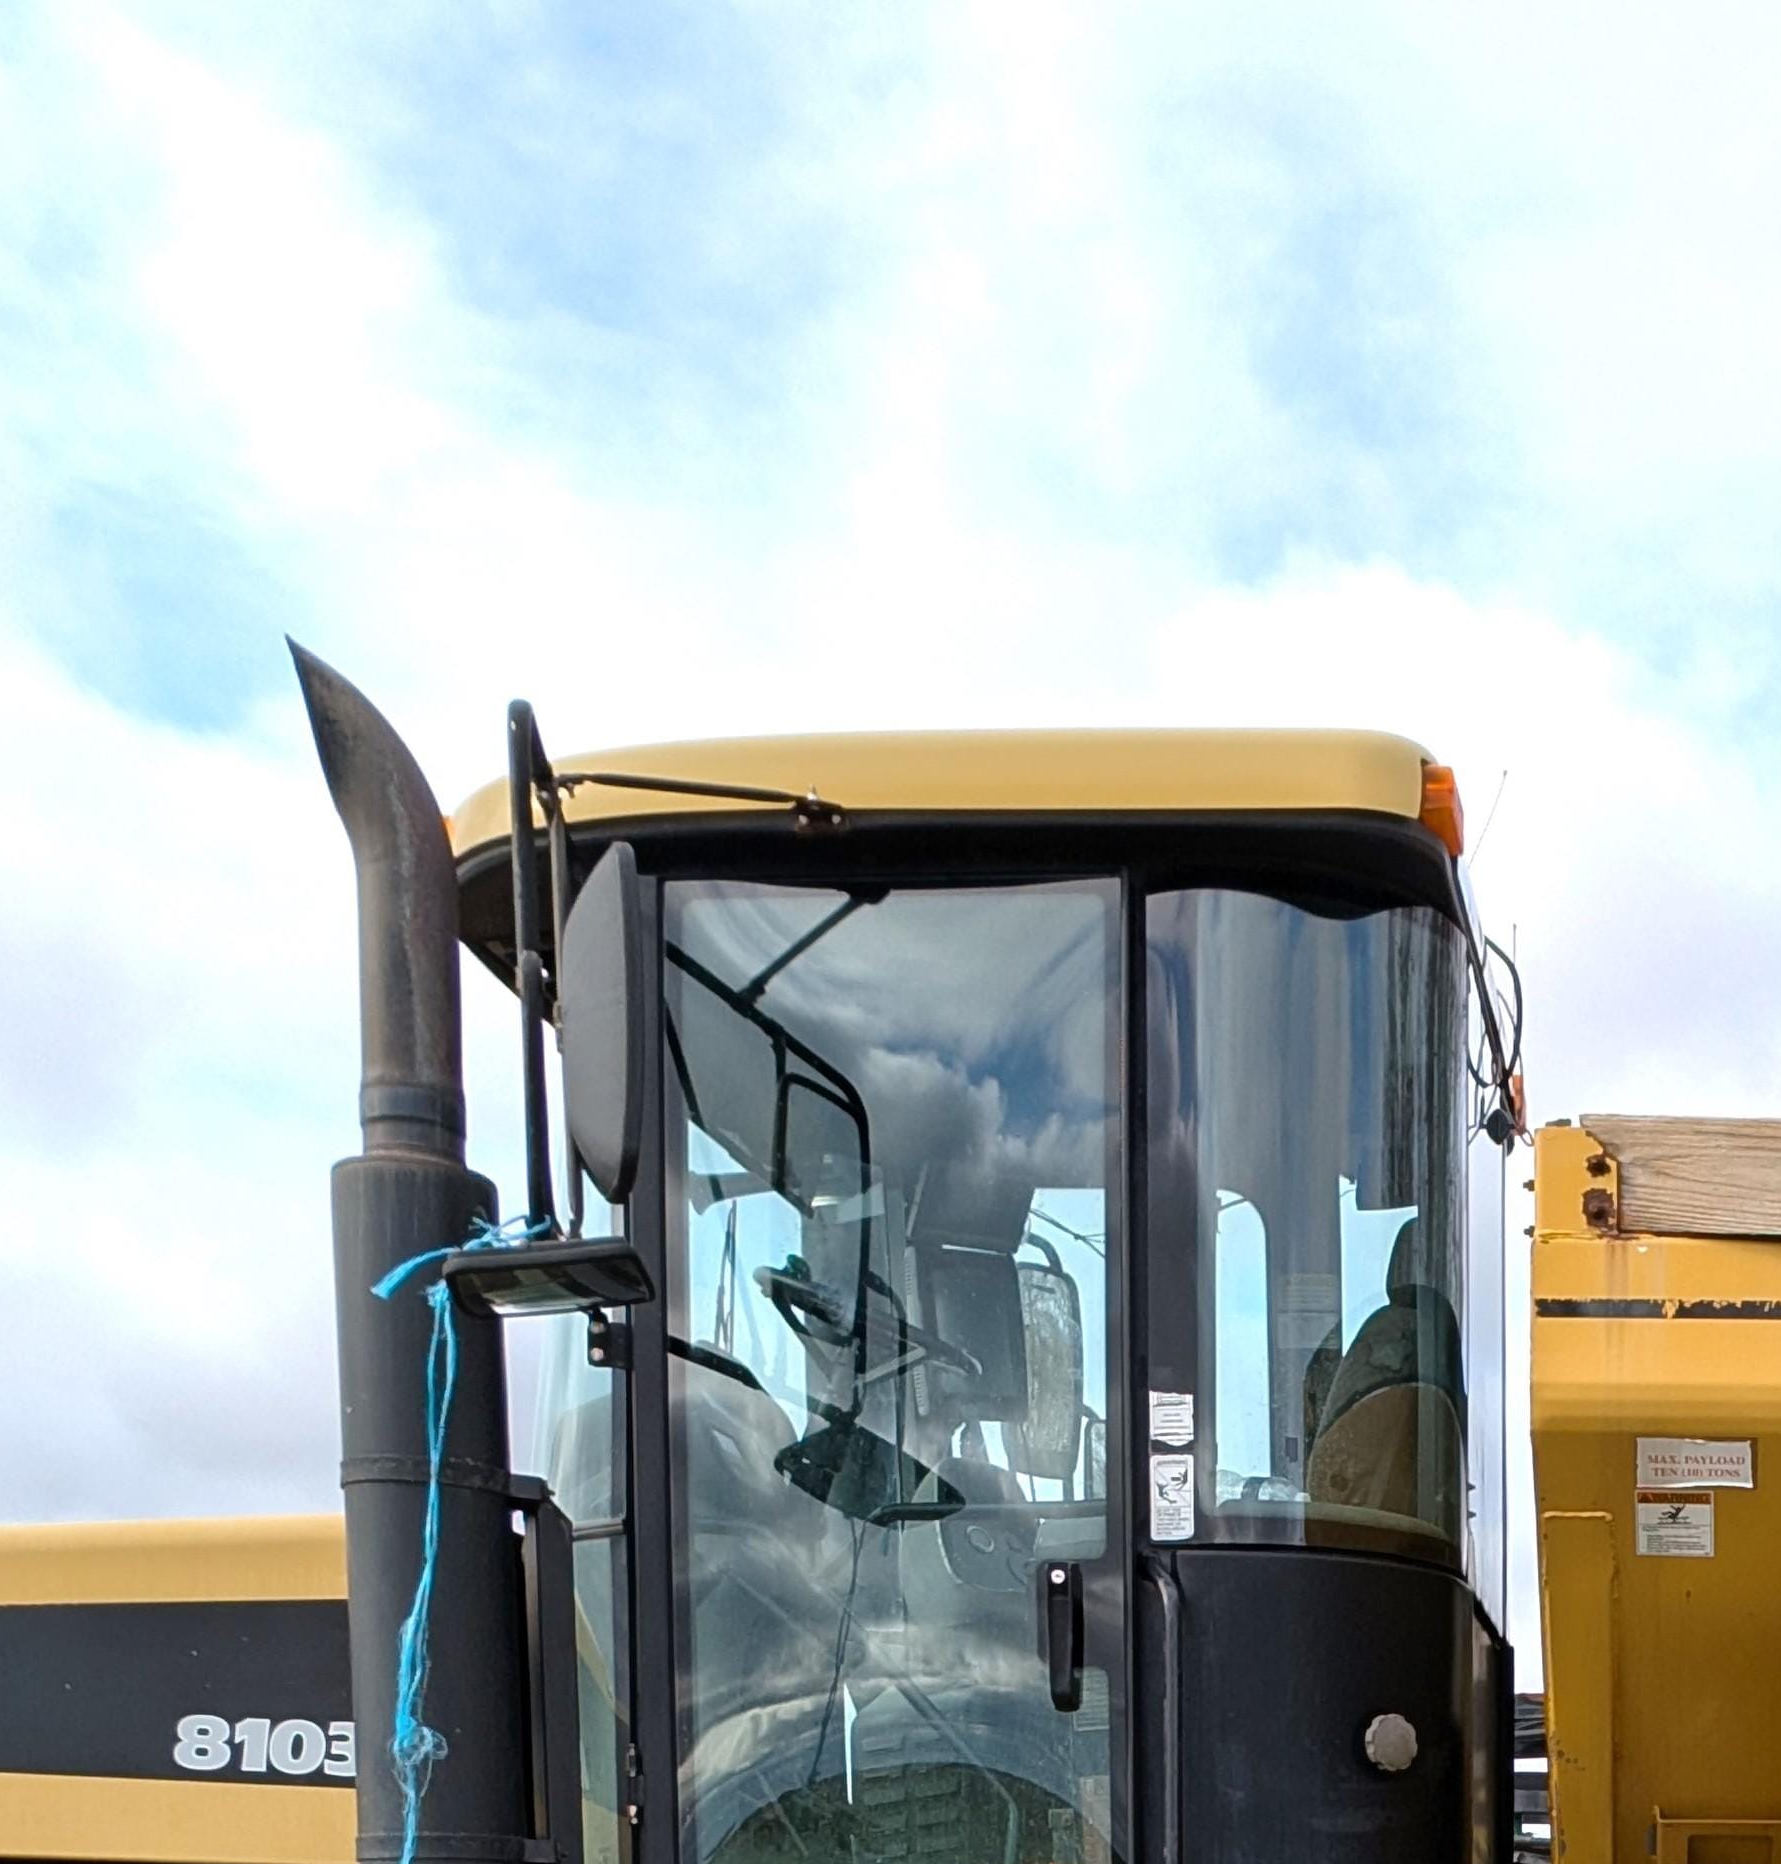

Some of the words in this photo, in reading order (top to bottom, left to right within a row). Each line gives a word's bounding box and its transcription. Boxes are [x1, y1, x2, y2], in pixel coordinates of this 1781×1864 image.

[1647, 1454, 1681, 1465] MAX.
[1684, 1455, 1746, 1466] PAYLOAD
[1651, 1467, 1678, 1478] TEN
[1706, 1468, 1741, 1478] TONS
[173, 1714, 356, 1777] 8103
